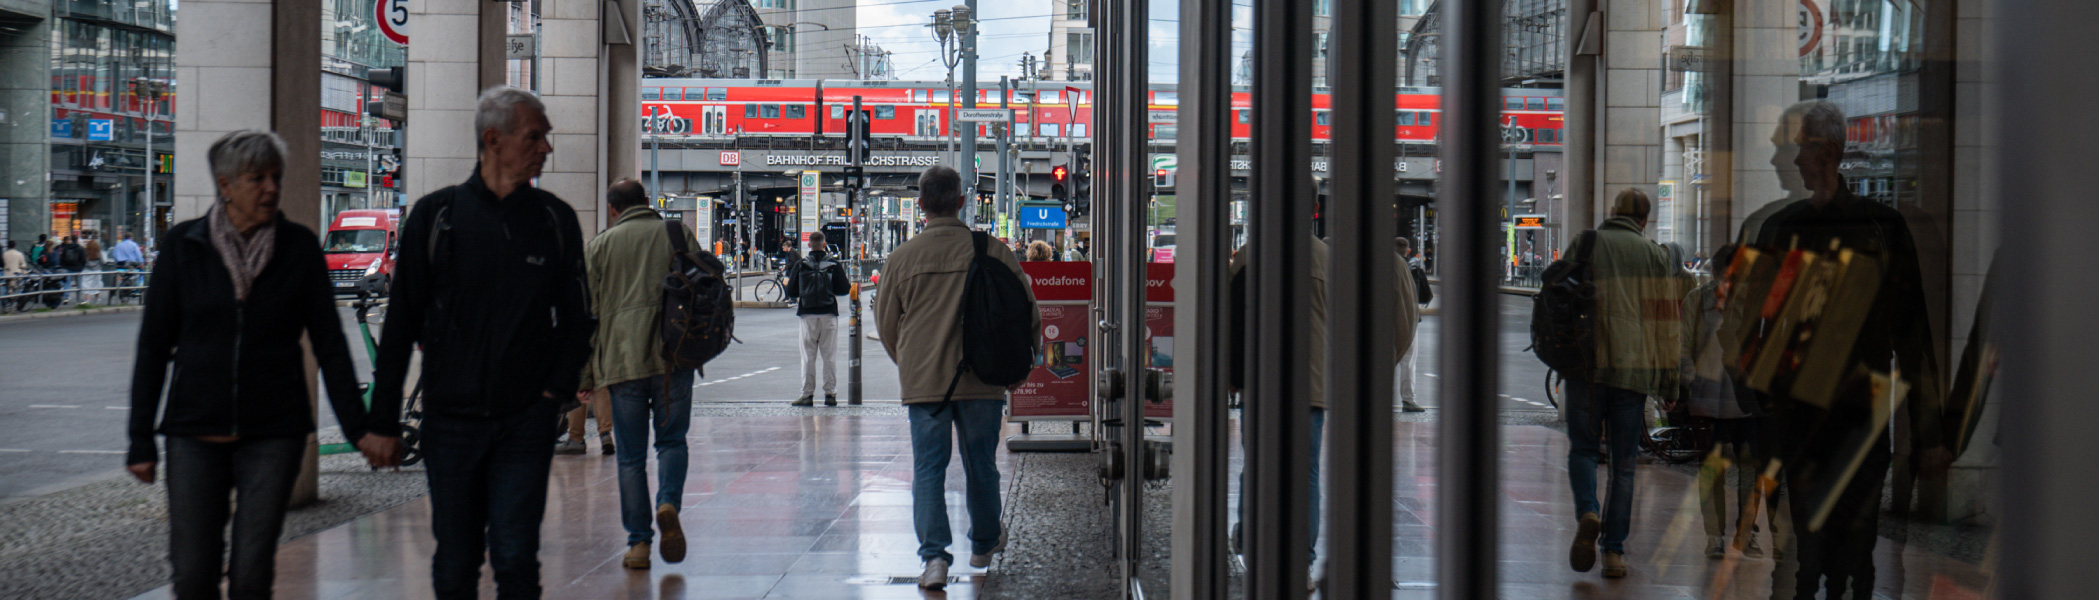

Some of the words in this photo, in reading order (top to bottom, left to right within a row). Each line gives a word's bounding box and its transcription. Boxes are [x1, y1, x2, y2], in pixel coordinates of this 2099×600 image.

[723, 153, 737, 163] DB
[767, 155, 823, 165] BAHNHOF
[826, 154, 940, 165] FRICHSTRASSE
[1039, 209, 1048, 219] U
[1035, 275, 1086, 286] vodafone
